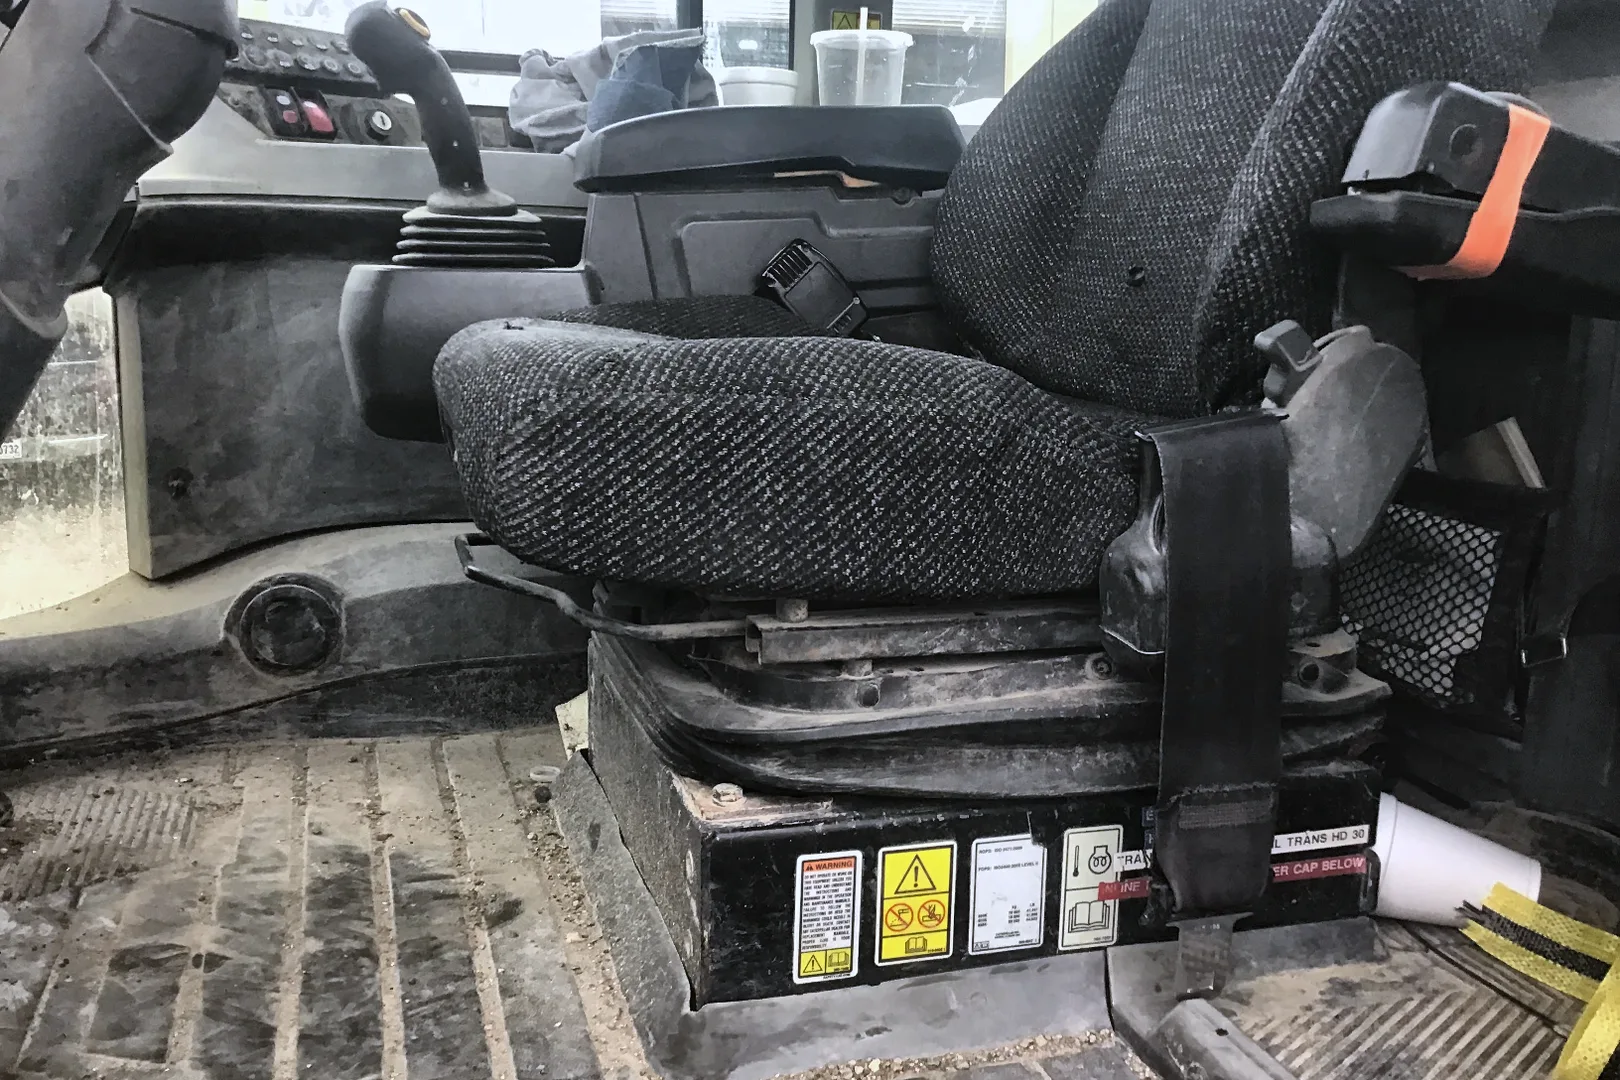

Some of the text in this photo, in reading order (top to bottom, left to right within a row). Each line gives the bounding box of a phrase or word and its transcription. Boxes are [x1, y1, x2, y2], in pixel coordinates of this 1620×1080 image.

[1287, 833, 1327, 847] TRANS
[1331, 831, 1348, 842] HD
[1352, 829, 1365, 840] 30
[815, 860, 852, 870] WARNING
[1293, 862, 1318, 875] CAP
[1321, 857, 1364, 871] BELOW
